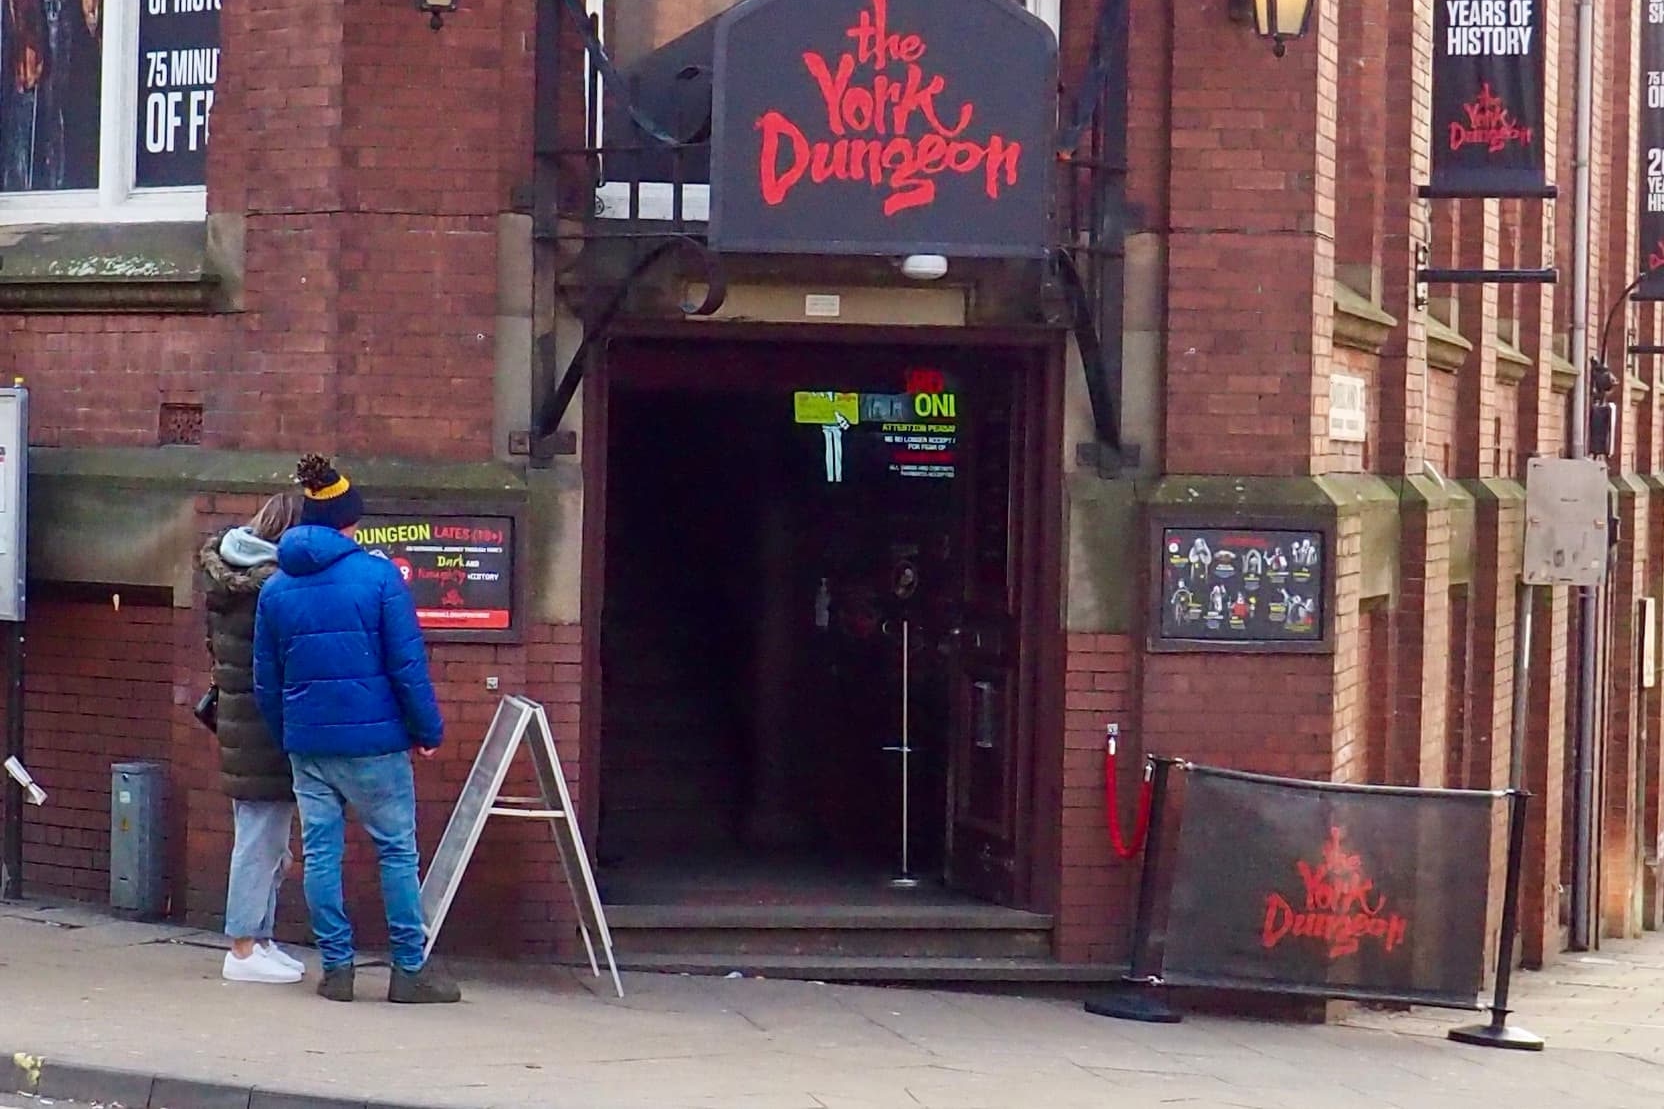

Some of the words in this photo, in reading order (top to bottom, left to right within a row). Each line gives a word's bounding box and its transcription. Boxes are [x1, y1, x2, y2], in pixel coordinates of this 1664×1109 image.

[1447, 0, 1506, 26] YEARS
[1509, 0, 1533, 26] OF
[146, 51, 168, 88] 75
[170, 48, 220, 86] MINU
[1447, 26, 1533, 56] HISTORY
[803, 51, 973, 137] York
[146, 92, 183, 153] OF
[754, 109, 1022, 217] Dungeon
[434, 525, 470, 539] LATES
[1296, 860, 1386, 915] York
[1263, 893, 1407, 958] Dungeon
